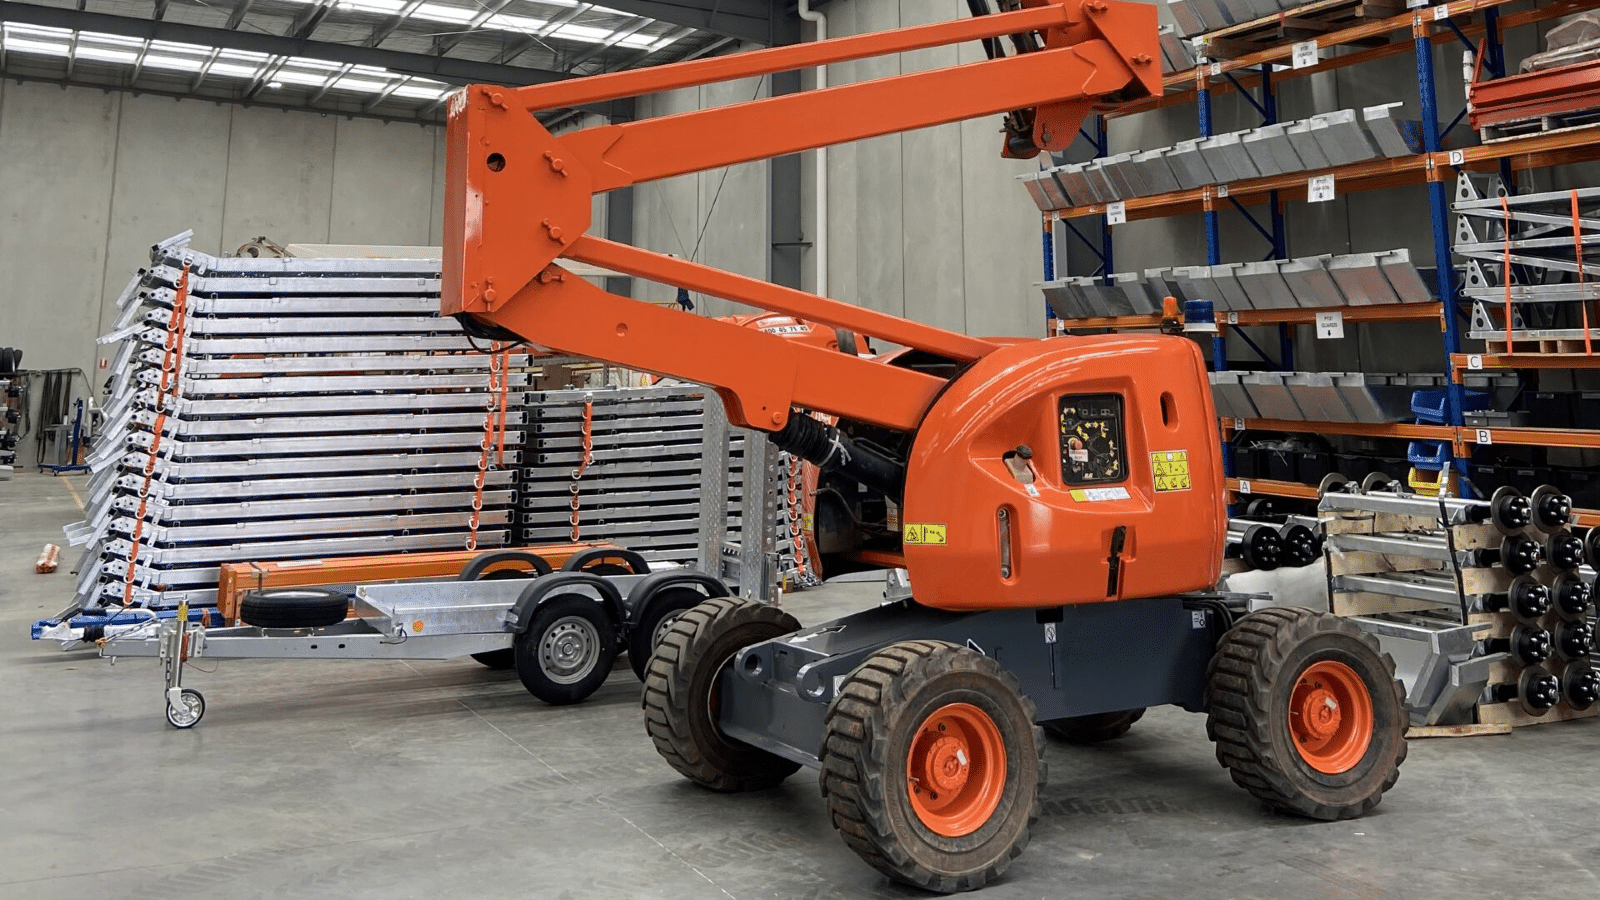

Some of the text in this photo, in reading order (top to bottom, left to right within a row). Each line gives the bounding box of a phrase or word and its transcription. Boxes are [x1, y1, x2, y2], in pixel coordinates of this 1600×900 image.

[1452, 151, 1462, 163] D
[1230, 312, 1237, 323] C
[1470, 355, 1479, 368] C
[1236, 418, 1244, 429] B
[1478, 430, 1488, 443] B
[1241, 481, 1249, 492] A
